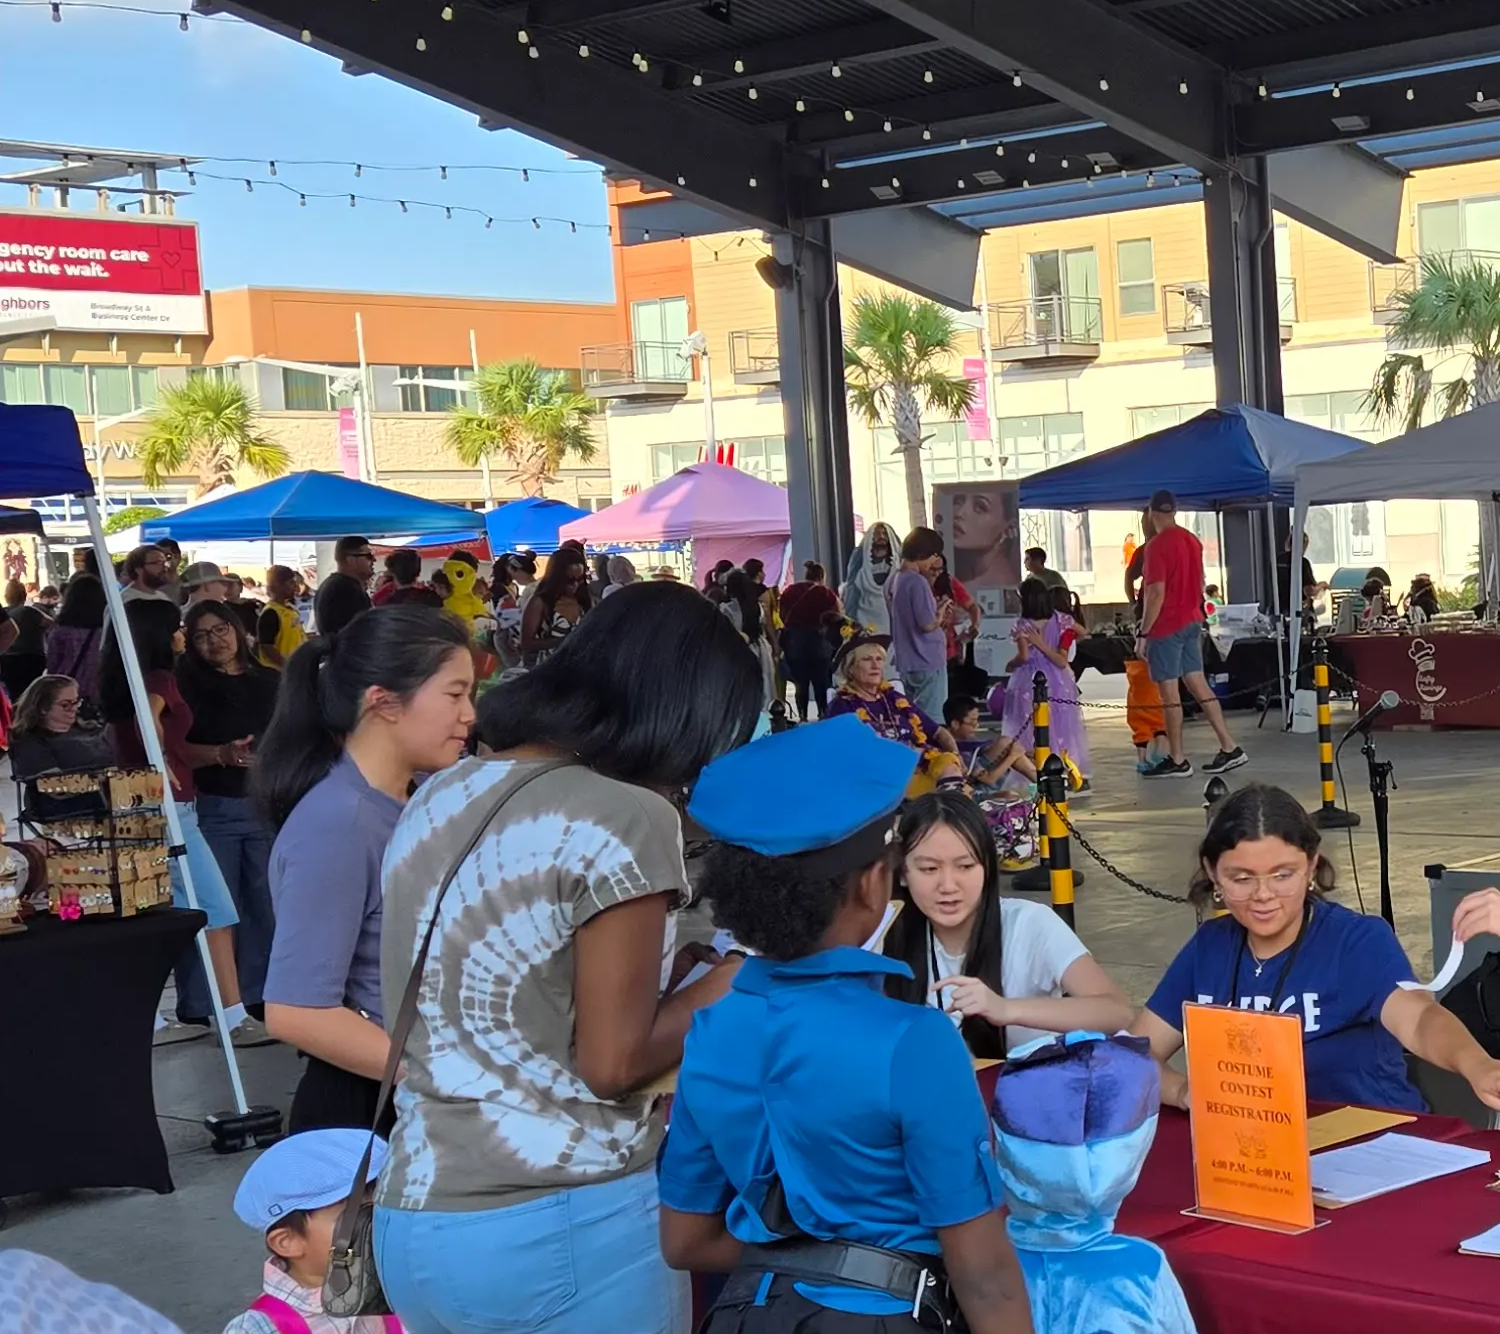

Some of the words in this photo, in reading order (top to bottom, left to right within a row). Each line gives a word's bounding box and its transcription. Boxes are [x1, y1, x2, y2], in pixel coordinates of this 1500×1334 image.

[59, 246, 107, 260] room
[110, 249, 150, 263] care
[28, 259, 61, 275] the
[63, 261, 110, 278] wait.
[1, 296, 50, 311] ghbors
[130, 314, 158, 322] Center
[1217, 1060, 1274, 1079] COSTUME
[1220, 1080, 1273, 1099] CONTEST
[1206, 1101, 1291, 1125] REGISTRATION
[1229, 1161, 1247, 1174] P.M.
[1275, 1170, 1294, 1182] P.M.
